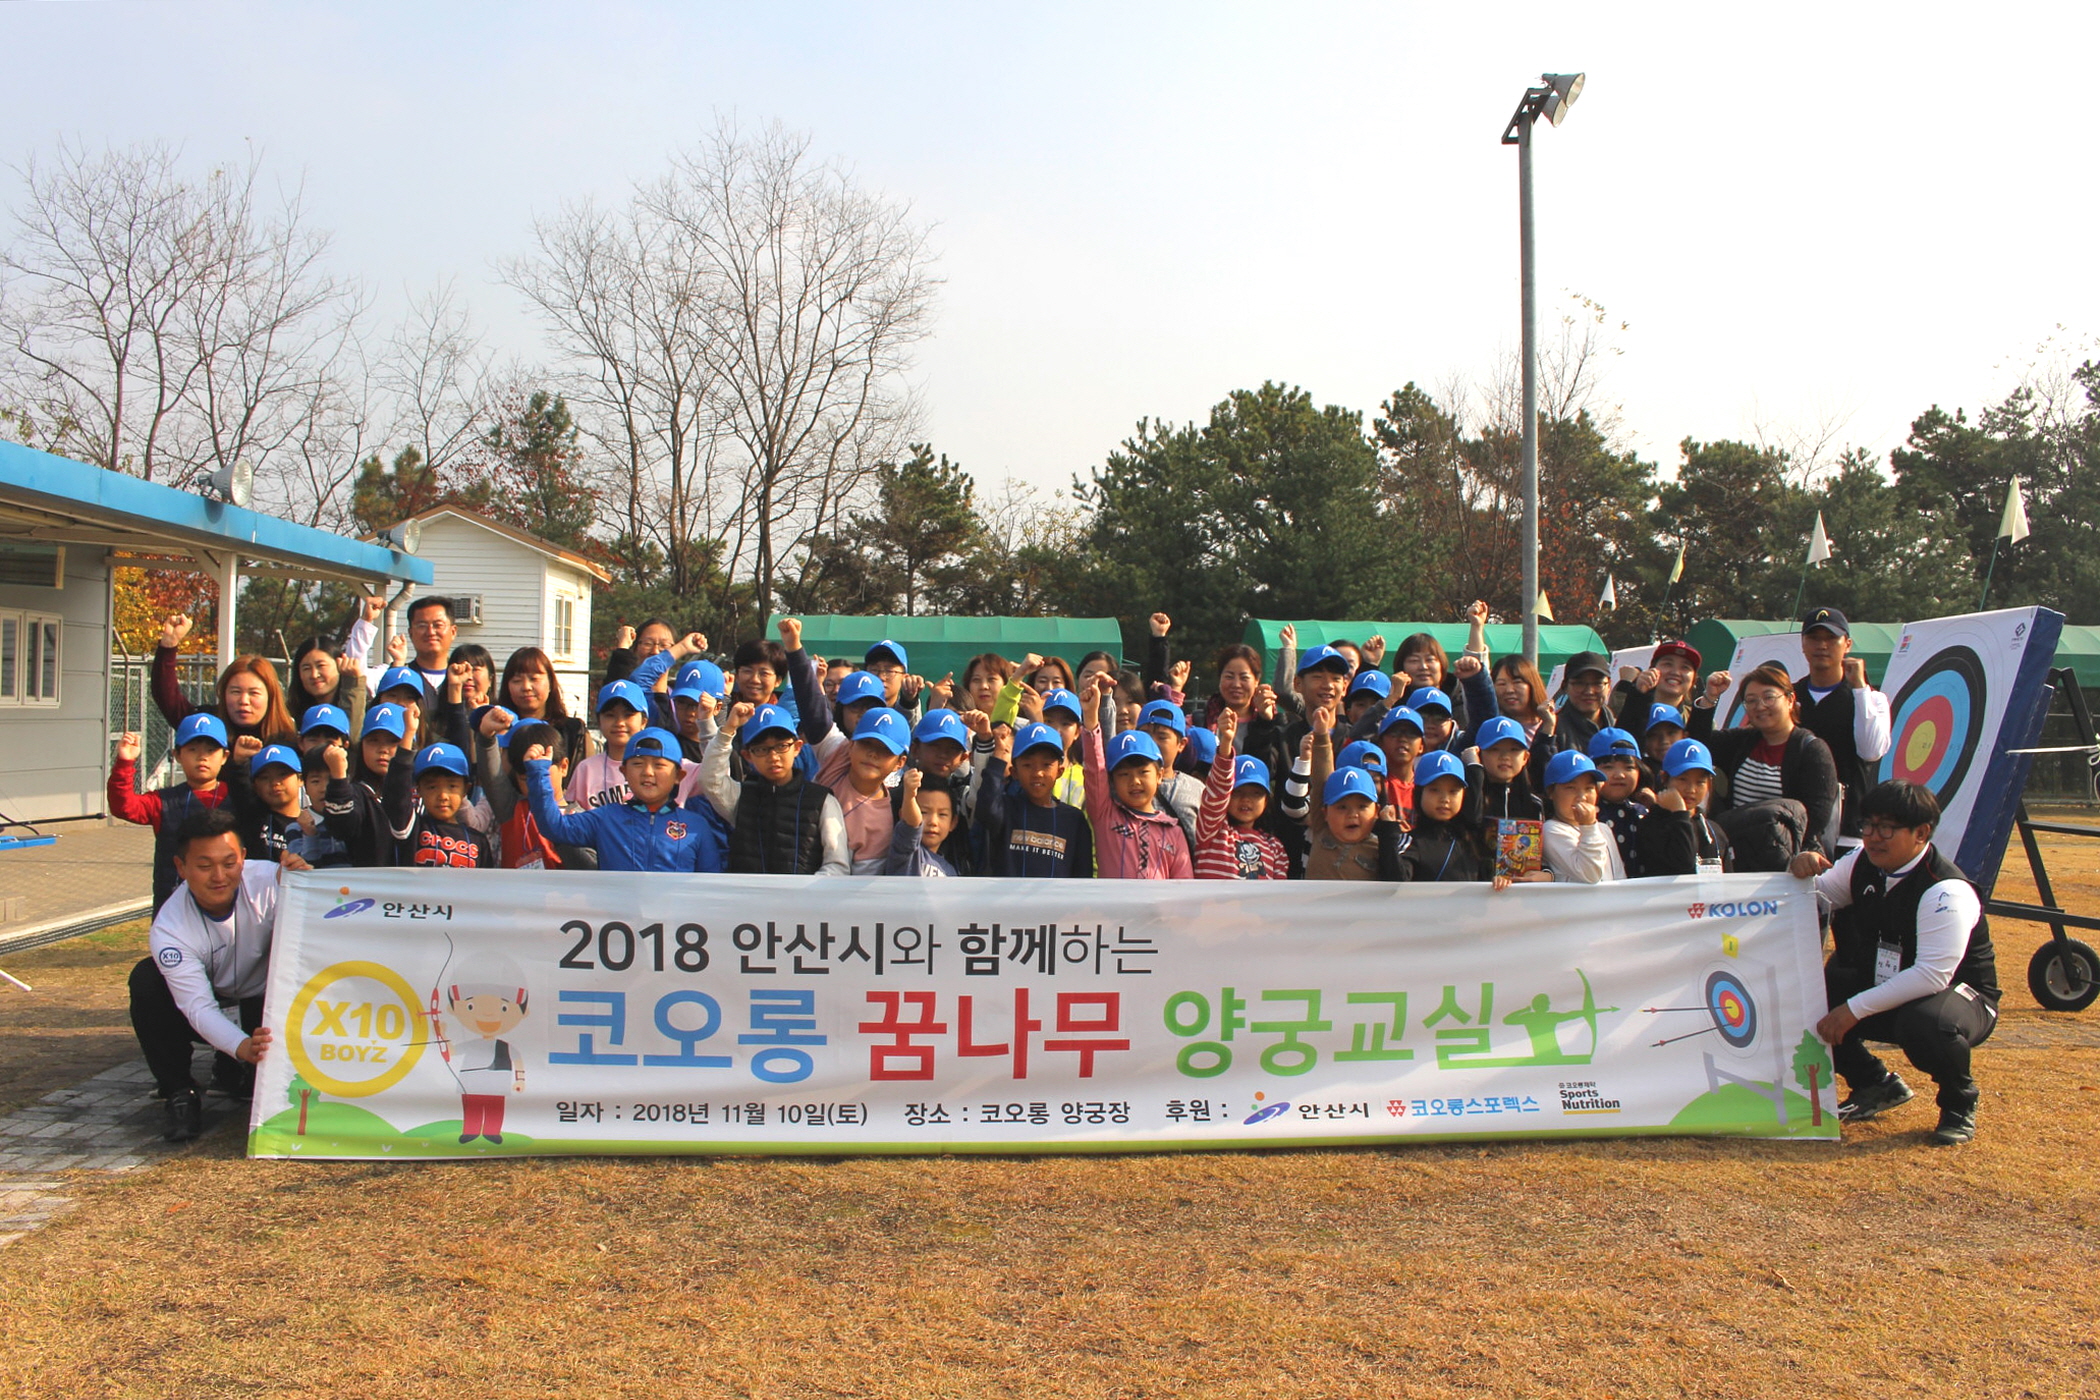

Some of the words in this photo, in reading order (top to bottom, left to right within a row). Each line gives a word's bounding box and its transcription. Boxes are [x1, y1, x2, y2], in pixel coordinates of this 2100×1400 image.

[382, 902, 453, 921] 안산시
[1708, 900, 1778, 917] KOLON
[559, 919, 709, 973] 2018
[732, 921, 942, 976] 안산시와
[957, 922, 1159, 976] 함께하는
[310, 1000, 404, 1040] X10
[549, 989, 827, 1084] 코오롱
[858, 987, 1131, 1082] 꿈나무
[1163, 982, 1494, 1079] 양궁교실
[320, 1040, 388, 1063] BOYZ
[1560, 1089, 1599, 1099] Sports
[1562, 1098, 1621, 1110] Nutrition
[556, 1101, 605, 1123] 일자
[632, 1103, 709, 1125] 2018년
[722, 1102, 766, 1126] 11월
[777, 1102, 868, 1127] 10일(토)
[904, 1102, 951, 1126] 장소
[980, 1102, 1050, 1125] 코오롱
[1061, 1101, 1131, 1125] 양궁장
[1165, 1099, 1211, 1123] 후원
[1298, 1102, 1370, 1120] 안산시
[1411, 1096, 1541, 1117] 코오롱스포렉스
